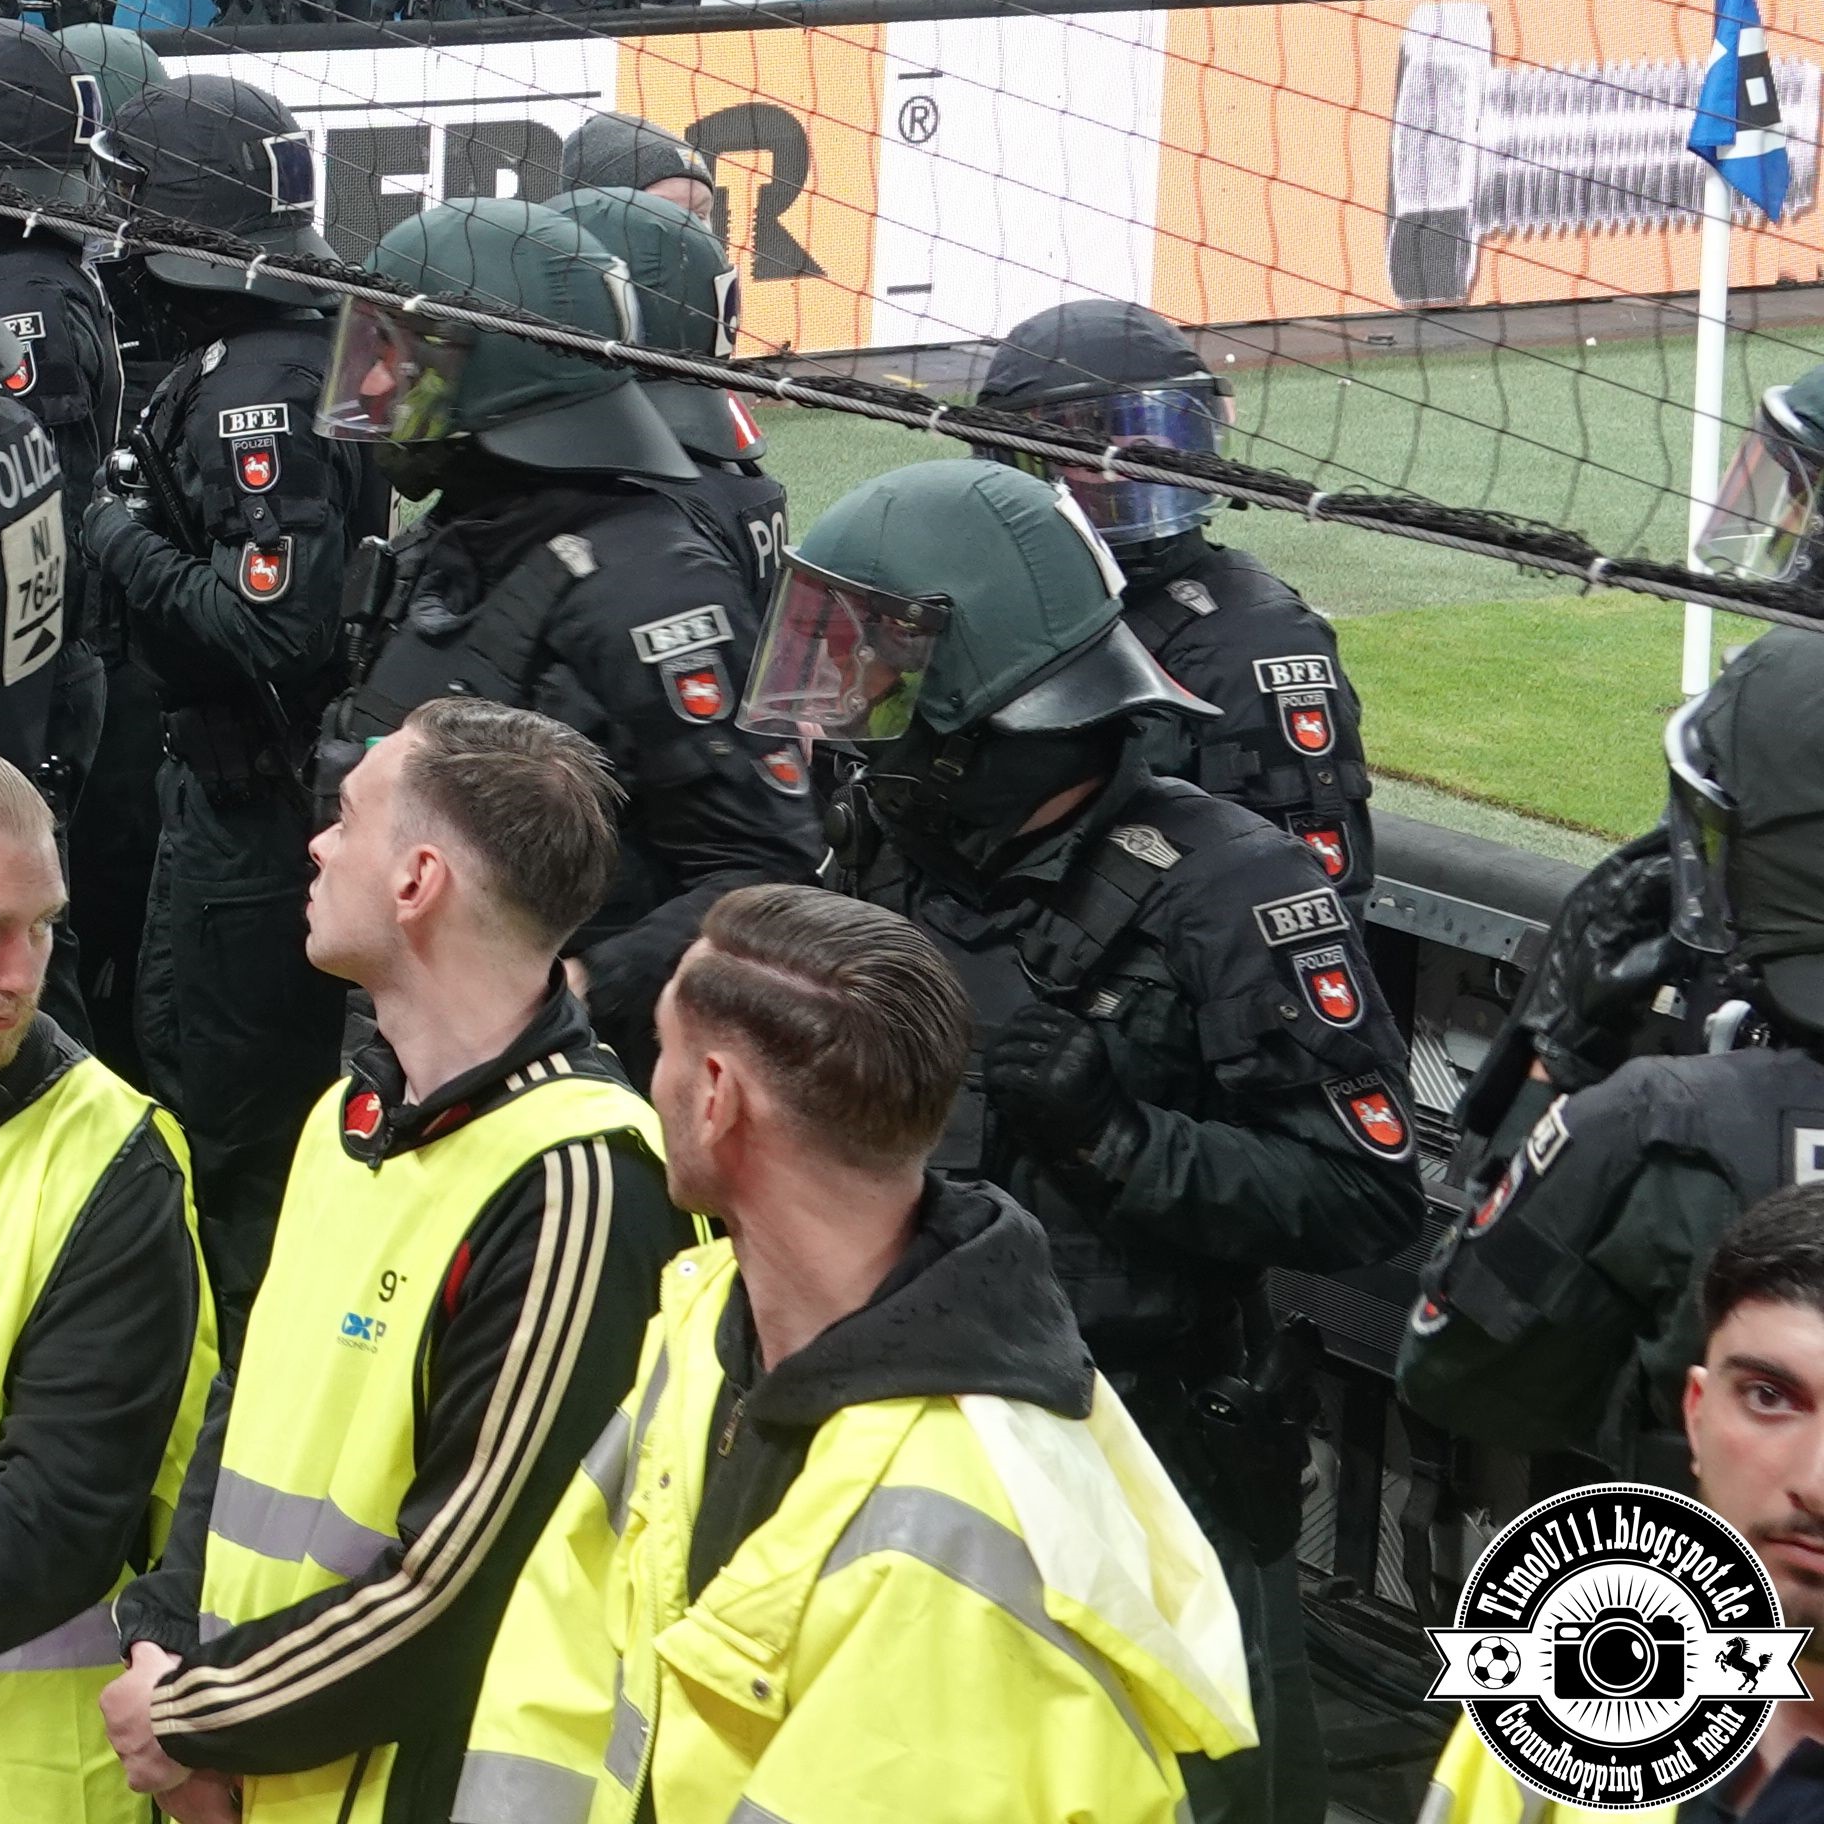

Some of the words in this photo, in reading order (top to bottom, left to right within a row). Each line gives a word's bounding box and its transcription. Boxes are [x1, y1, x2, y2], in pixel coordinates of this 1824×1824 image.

[5, 316, 35, 336] FE
[228, 408, 278, 433] BFE
[235, 437, 273, 450] POLIZEI
[1268, 659, 1326, 685] BFE
[1267, 897, 1338, 937] BFE
